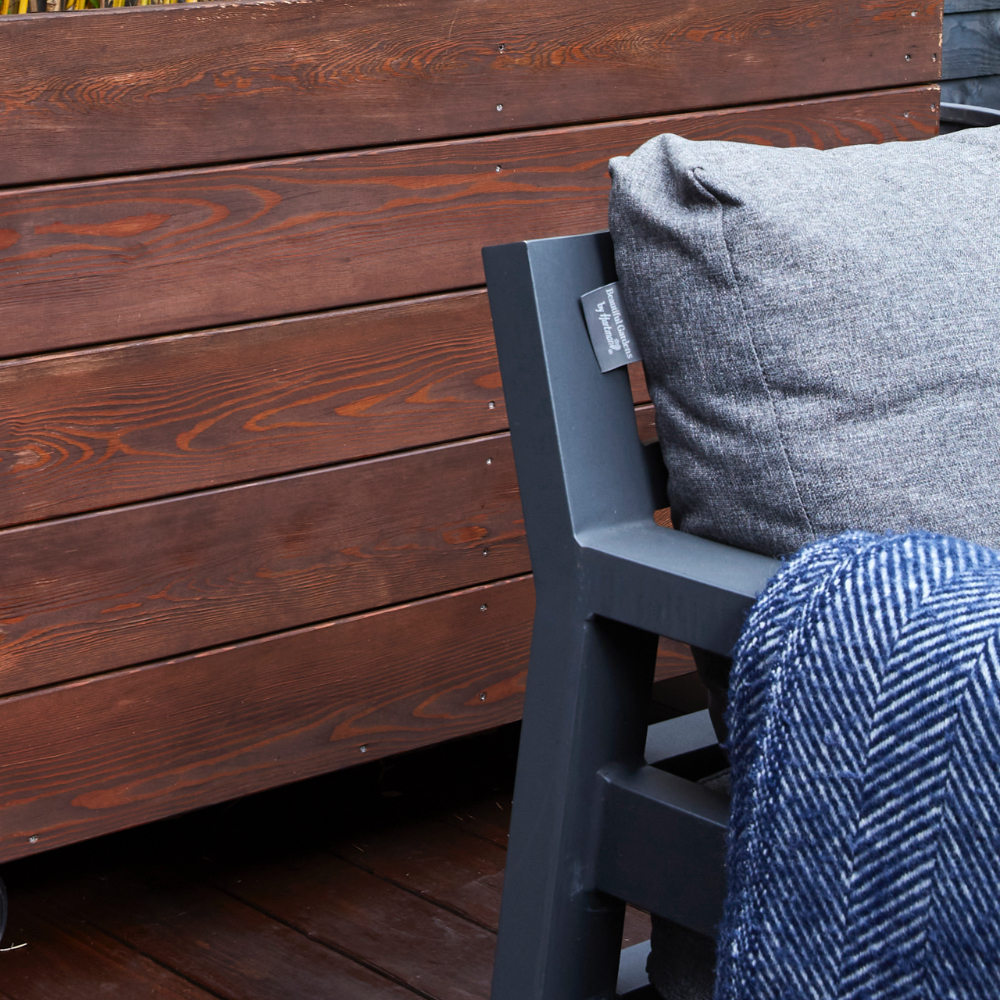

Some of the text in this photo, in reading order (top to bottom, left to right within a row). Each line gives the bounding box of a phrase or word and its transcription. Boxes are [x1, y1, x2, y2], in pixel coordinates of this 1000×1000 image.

[595, 301, 615, 348] by Hartman
[605, 288, 633, 359] Beautiful Gardens
